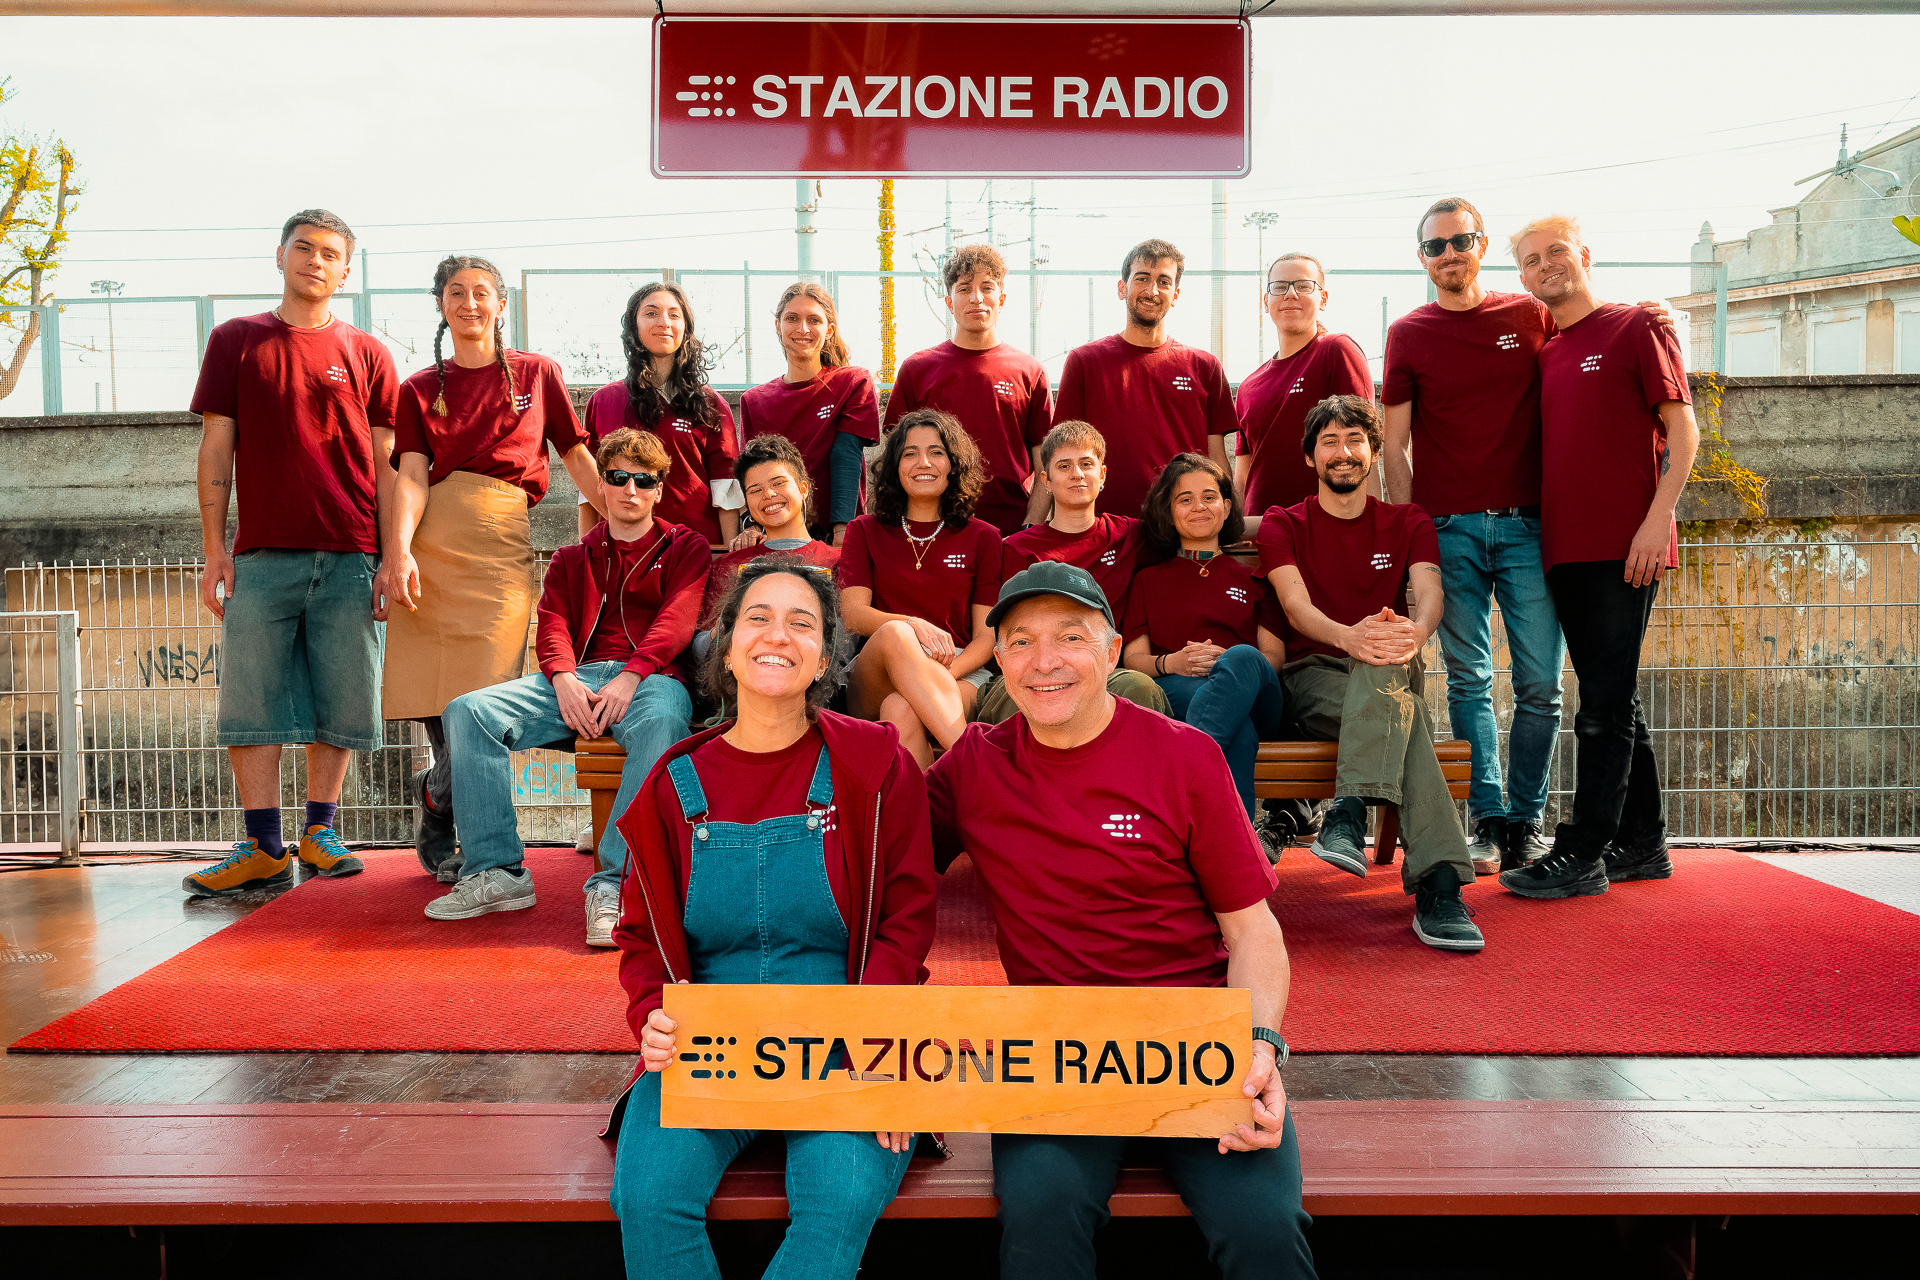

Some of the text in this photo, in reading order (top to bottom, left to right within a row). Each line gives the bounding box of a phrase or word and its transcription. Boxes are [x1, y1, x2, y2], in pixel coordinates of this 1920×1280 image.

[752, 75, 1229, 119] STAZIONE RADIO
[753, 1036, 1235, 1087] STAZIONE RADIO
